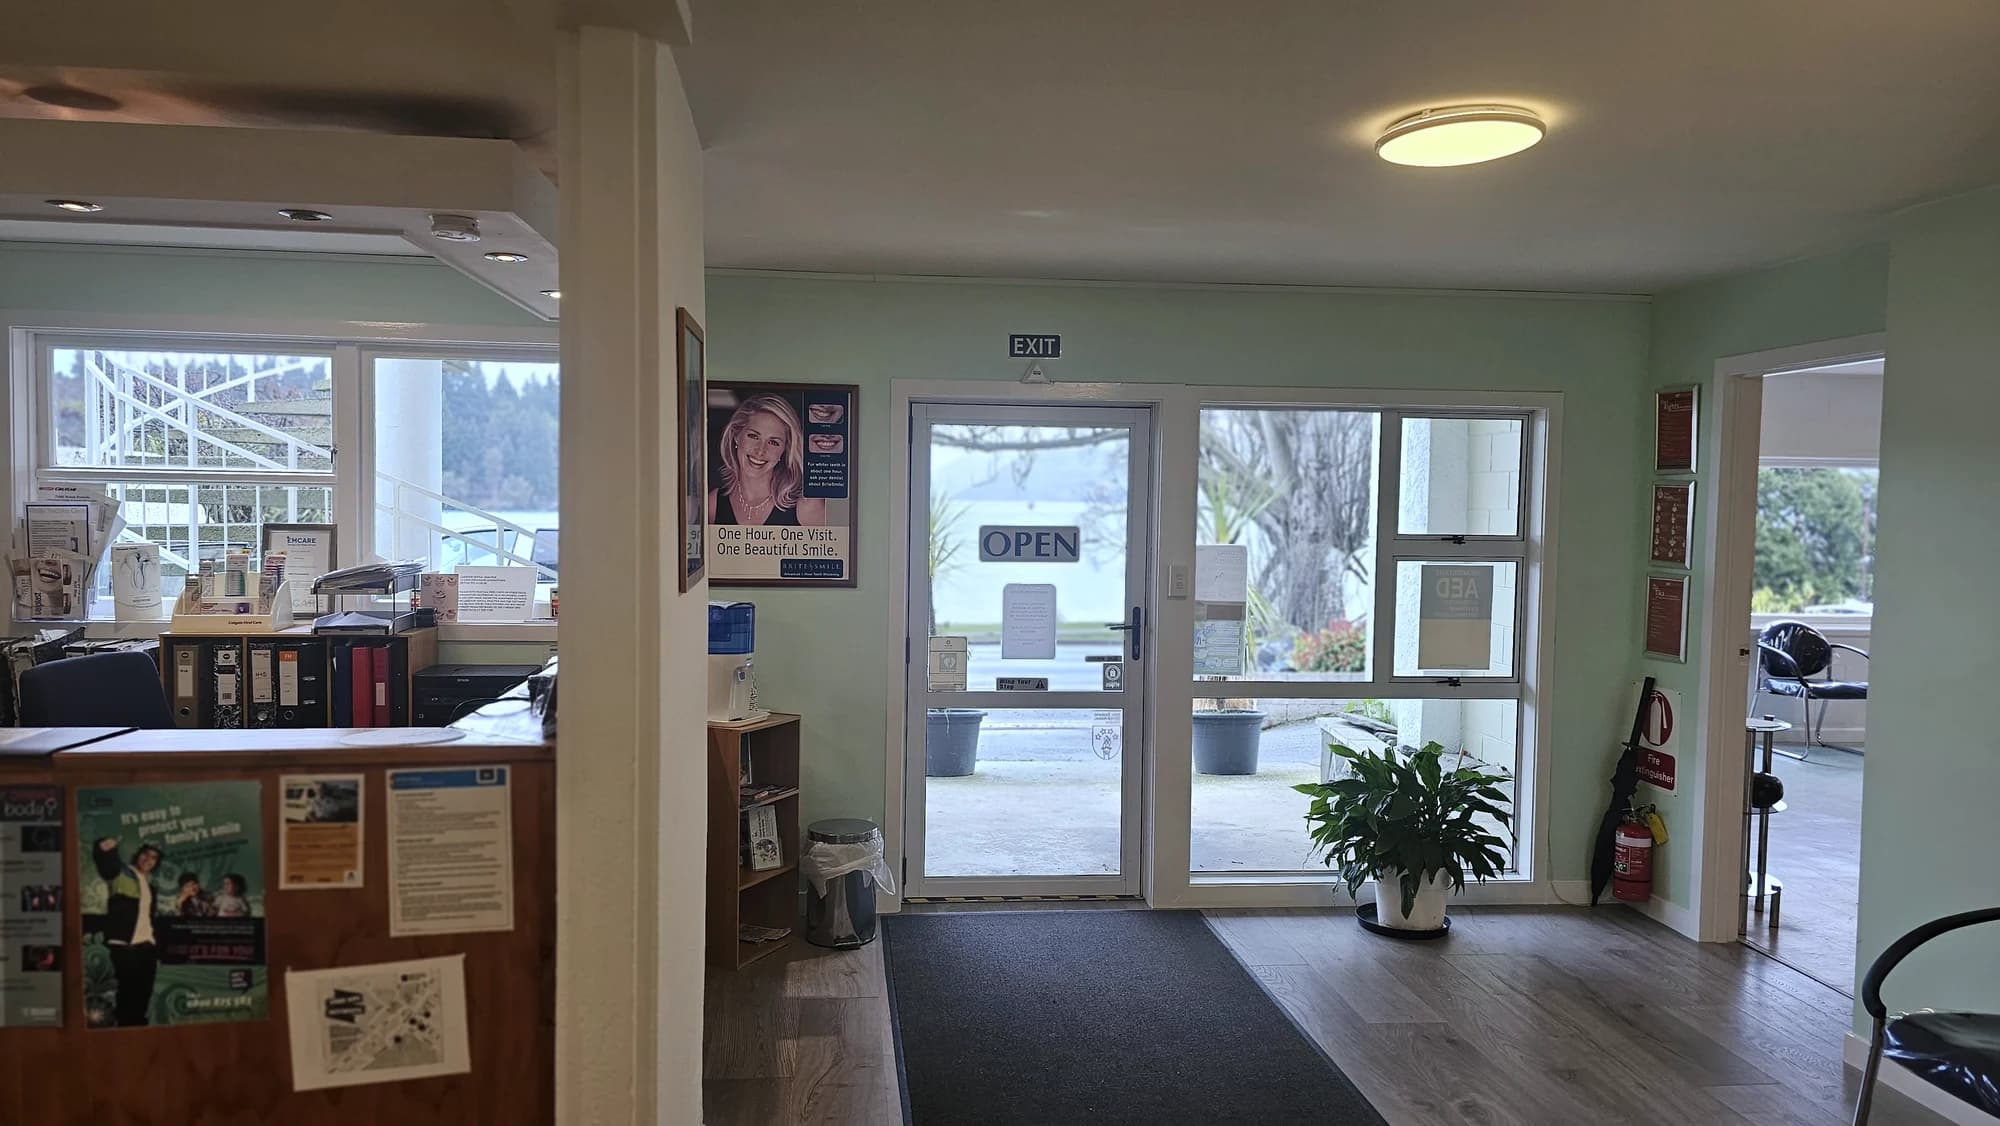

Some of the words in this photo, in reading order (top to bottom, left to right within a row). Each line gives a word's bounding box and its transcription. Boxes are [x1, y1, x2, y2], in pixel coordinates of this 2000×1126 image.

[1013, 337, 1056, 355] EXIT
[718, 527, 741, 540] One
[746, 528, 776, 541] Hour.
[781, 528, 804, 541] One
[808, 528, 837, 541] Visit.
[983, 530, 1078, 557] OPEN
[717, 542, 740, 555] One
[745, 542, 798, 556] Beautiful
[802, 543, 838, 556] Smile.
[1647, 753, 1661, 766] Fire
[1634, 766, 1674, 784] xtinguisher
[4, 797, 57, 823] body?
[121, 811, 139, 826] It's
[141, 809, 168, 823] easy
[169, 804, 182, 816] to
[138, 820, 179, 838] protect
[180, 815, 206, 830] your
[165, 828, 208, 845] family's
[211, 820, 242, 838] smile
